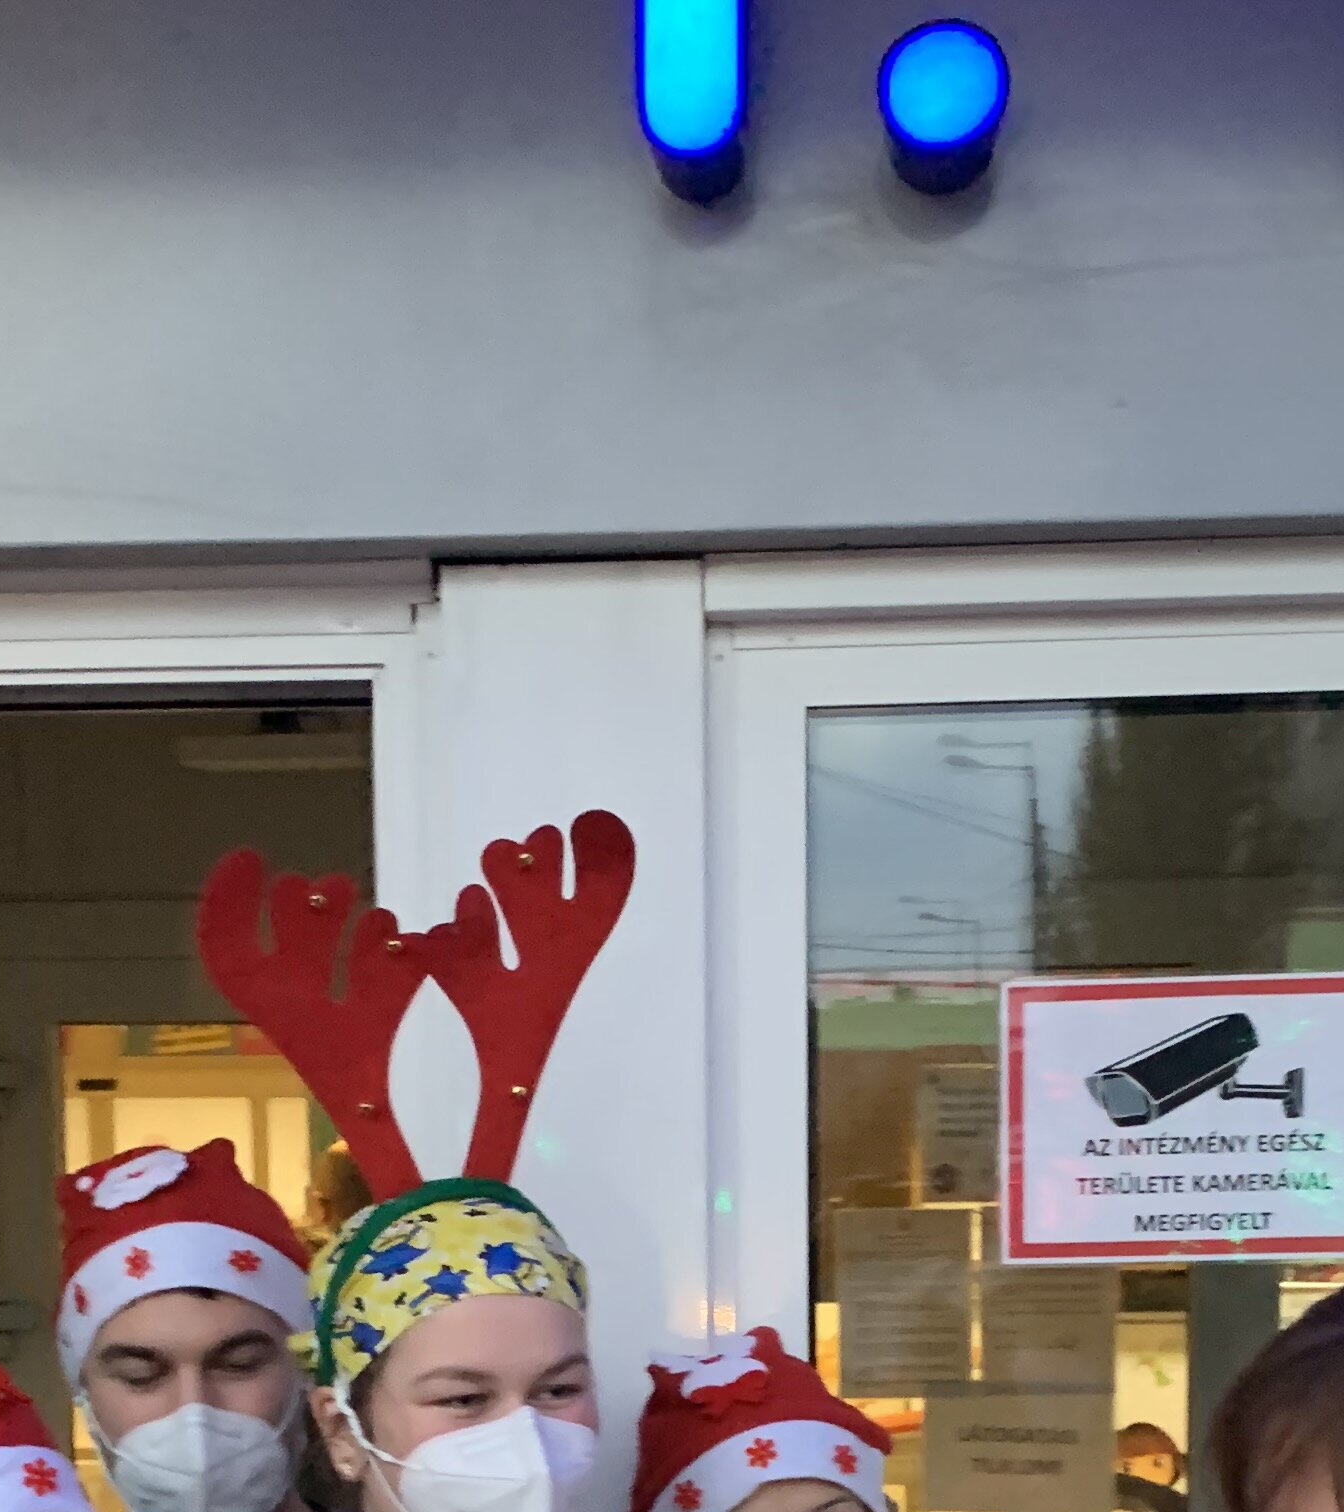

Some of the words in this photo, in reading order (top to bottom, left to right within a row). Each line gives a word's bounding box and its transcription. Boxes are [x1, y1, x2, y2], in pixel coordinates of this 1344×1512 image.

[1082, 1137, 1112, 1157] AZ
[1118, 1131, 1251, 1156] INTÉZMÉNY
[1257, 1128, 1327, 1152] EGÉSZ
[1075, 1172, 1185, 1195] TERÜLETE
[1192, 1168, 1334, 1193] KAMERÁVAL
[1134, 1211, 1274, 1232] MEGFIGYELT
